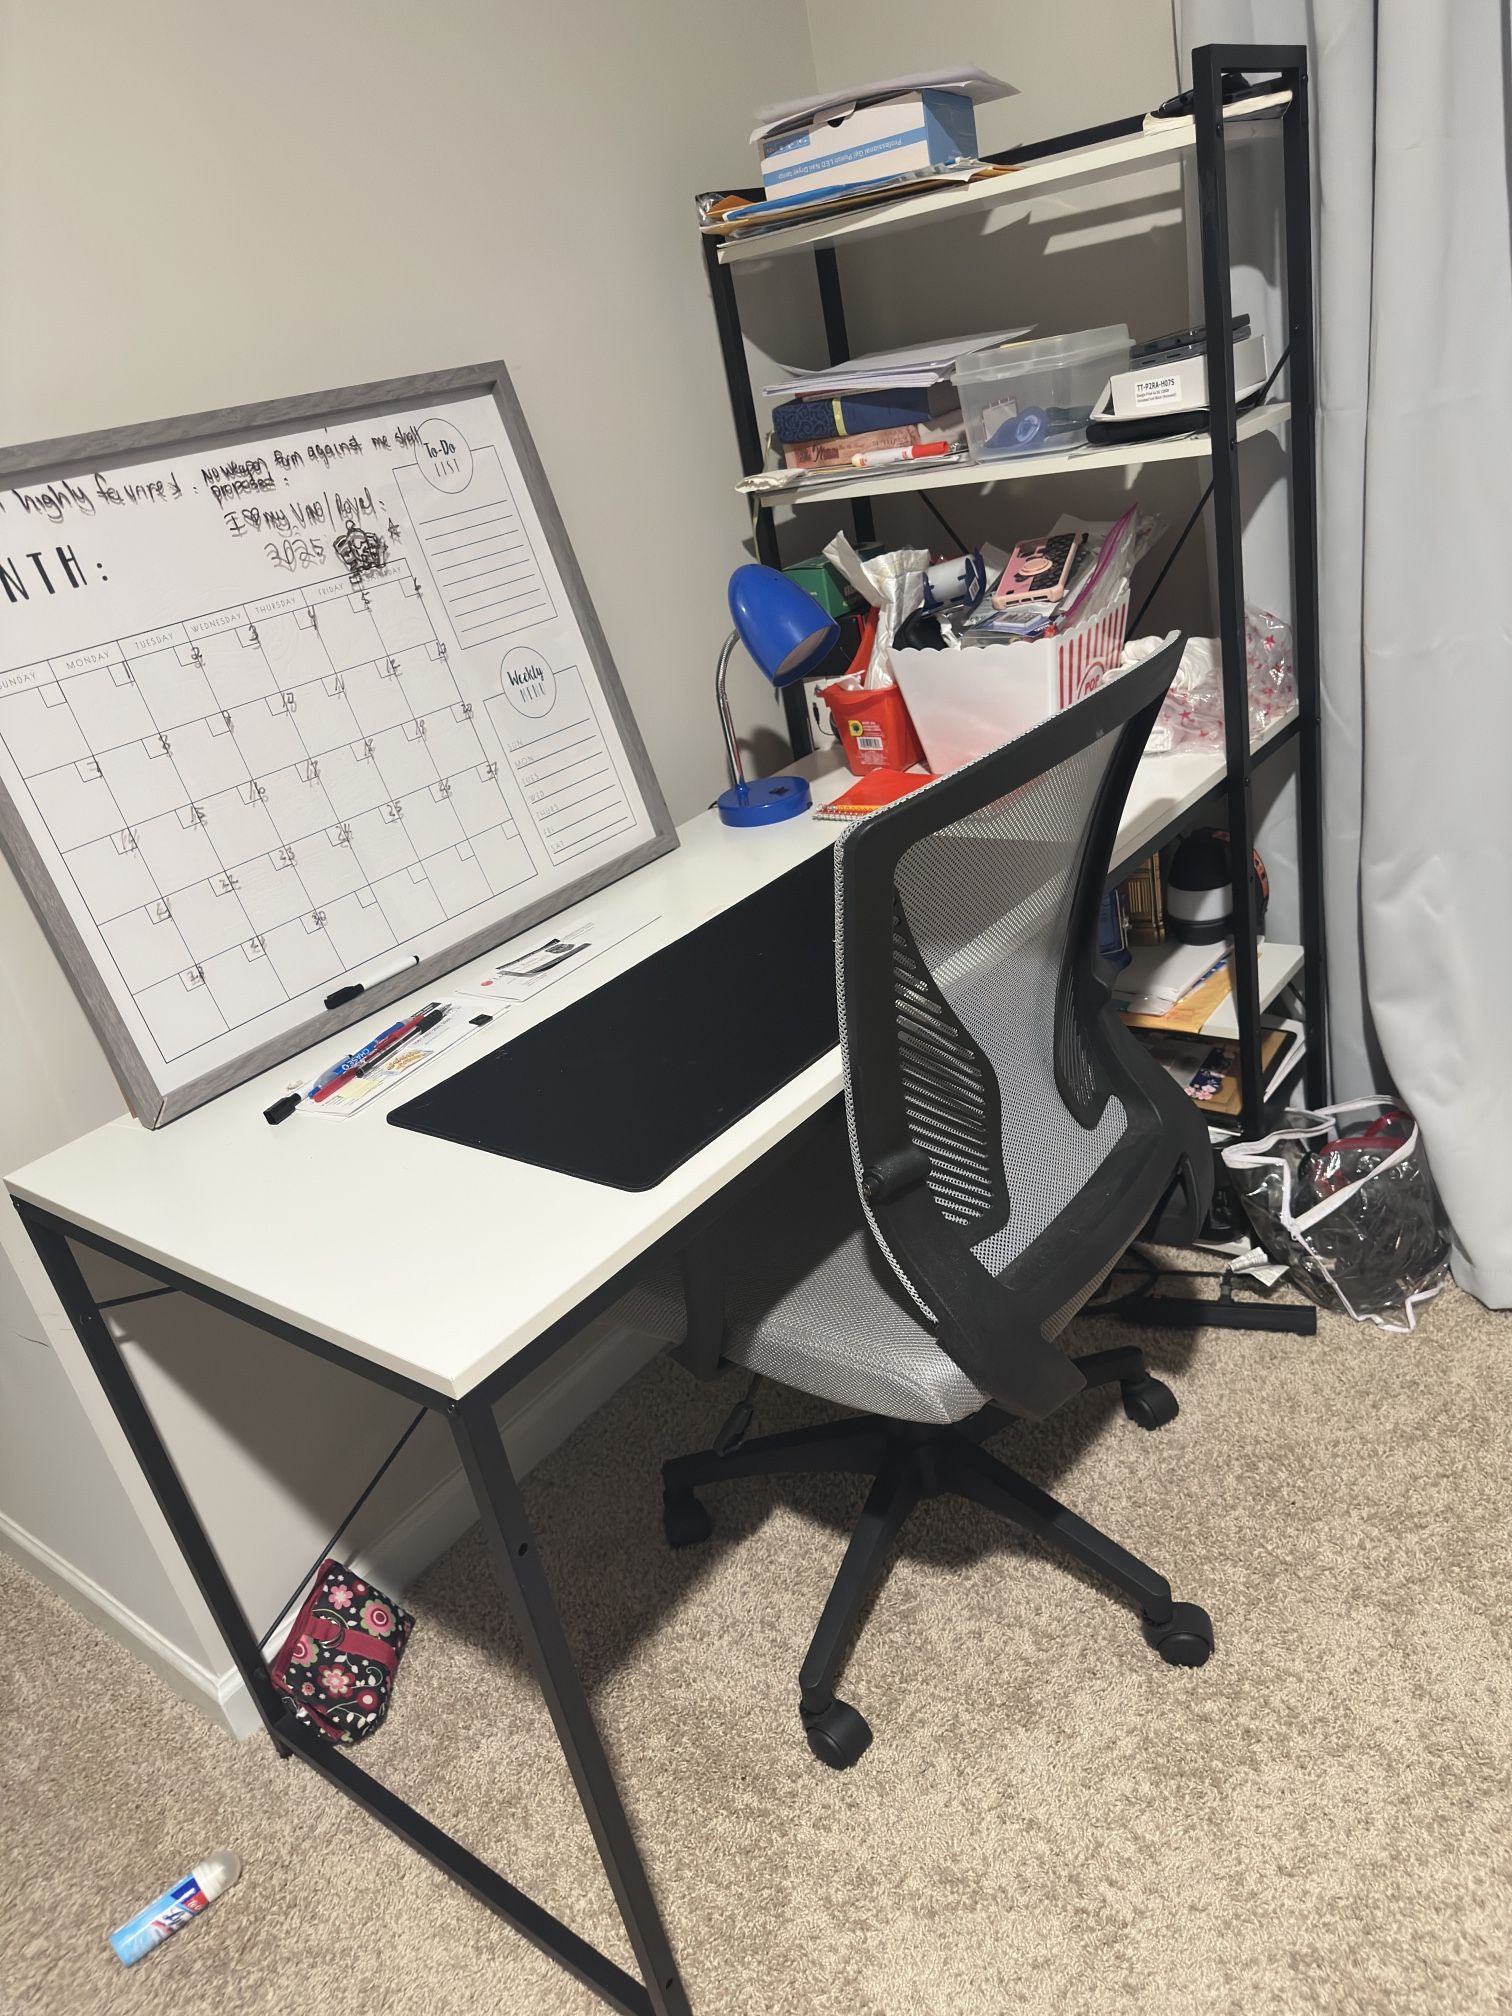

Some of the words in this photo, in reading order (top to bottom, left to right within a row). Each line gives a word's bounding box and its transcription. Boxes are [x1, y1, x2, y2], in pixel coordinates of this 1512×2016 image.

[307, 435, 362, 468] against
[371, 435, 391, 449] me
[424, 439, 457, 458] To-Do
[11, 480, 96, 523] highly
[264, 538, 326, 571] 2025
[318, 583, 345, 596] FRIDAY
[255, 597, 296, 614] THURSDAY
[190, 613, 243, 633] WEDNESDAY
[134, 632, 174, 651] TUESDAY
[66, 651, 110, 670] MONDAY
[506, 664, 545, 686] Weekly
[386, 800, 403, 818] 25
[348, 1048, 370, 1067] CHASE
